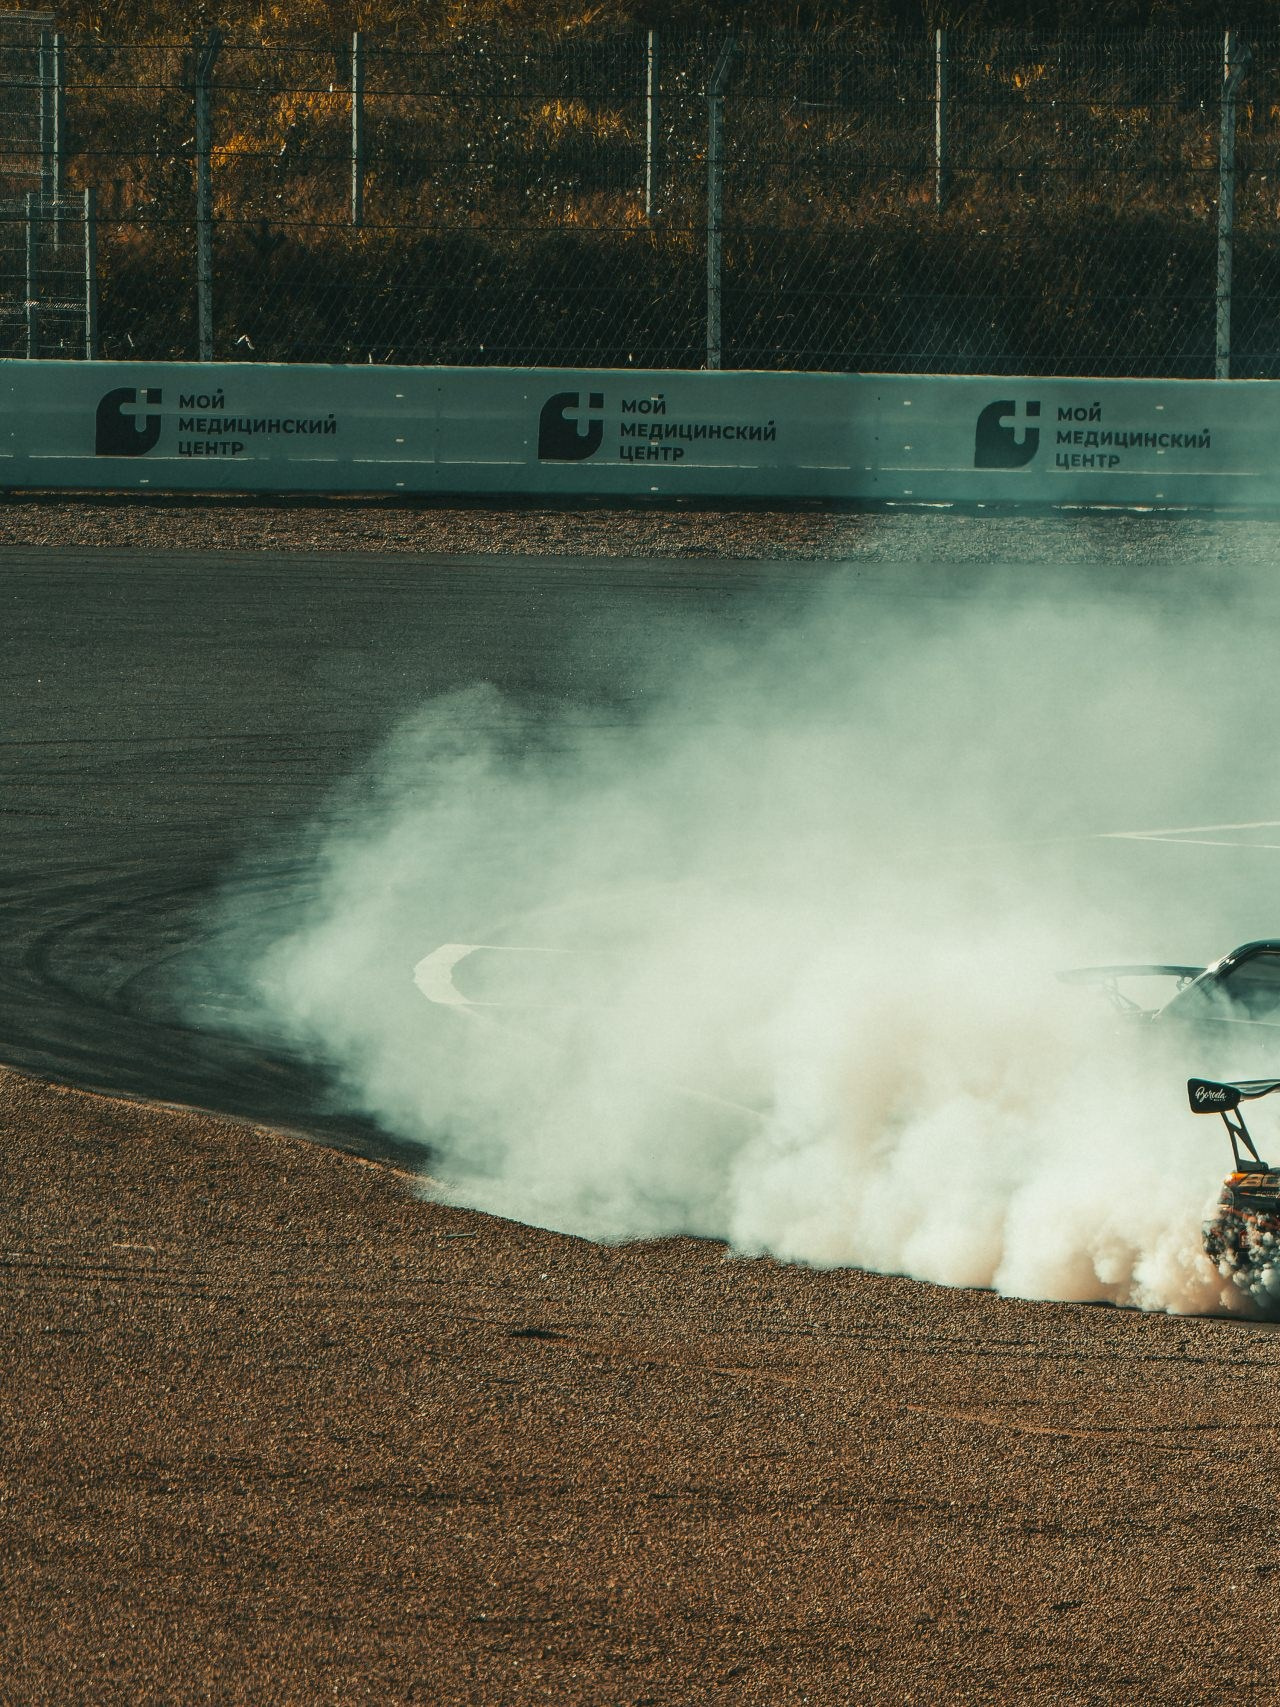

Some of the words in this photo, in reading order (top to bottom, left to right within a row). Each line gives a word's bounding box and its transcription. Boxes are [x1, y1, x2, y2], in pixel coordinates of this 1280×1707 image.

[179, 388, 225, 409] МОЙ
[621, 393, 666, 415] МОЙ
[1057, 402, 1102, 423] МОЙ
[178, 413, 337, 435] МЕДИЦИНСКИЙ
[620, 420, 777, 441] МЕДИЦИНСКИЙ
[178, 441, 244, 457] ЦЕНТР
[1056, 428, 1211, 449] МЕДИЦИНСКИЙ
[619, 445, 684, 461] ЦЕНТР
[1055, 453, 1120, 470] ЦЕНТР
